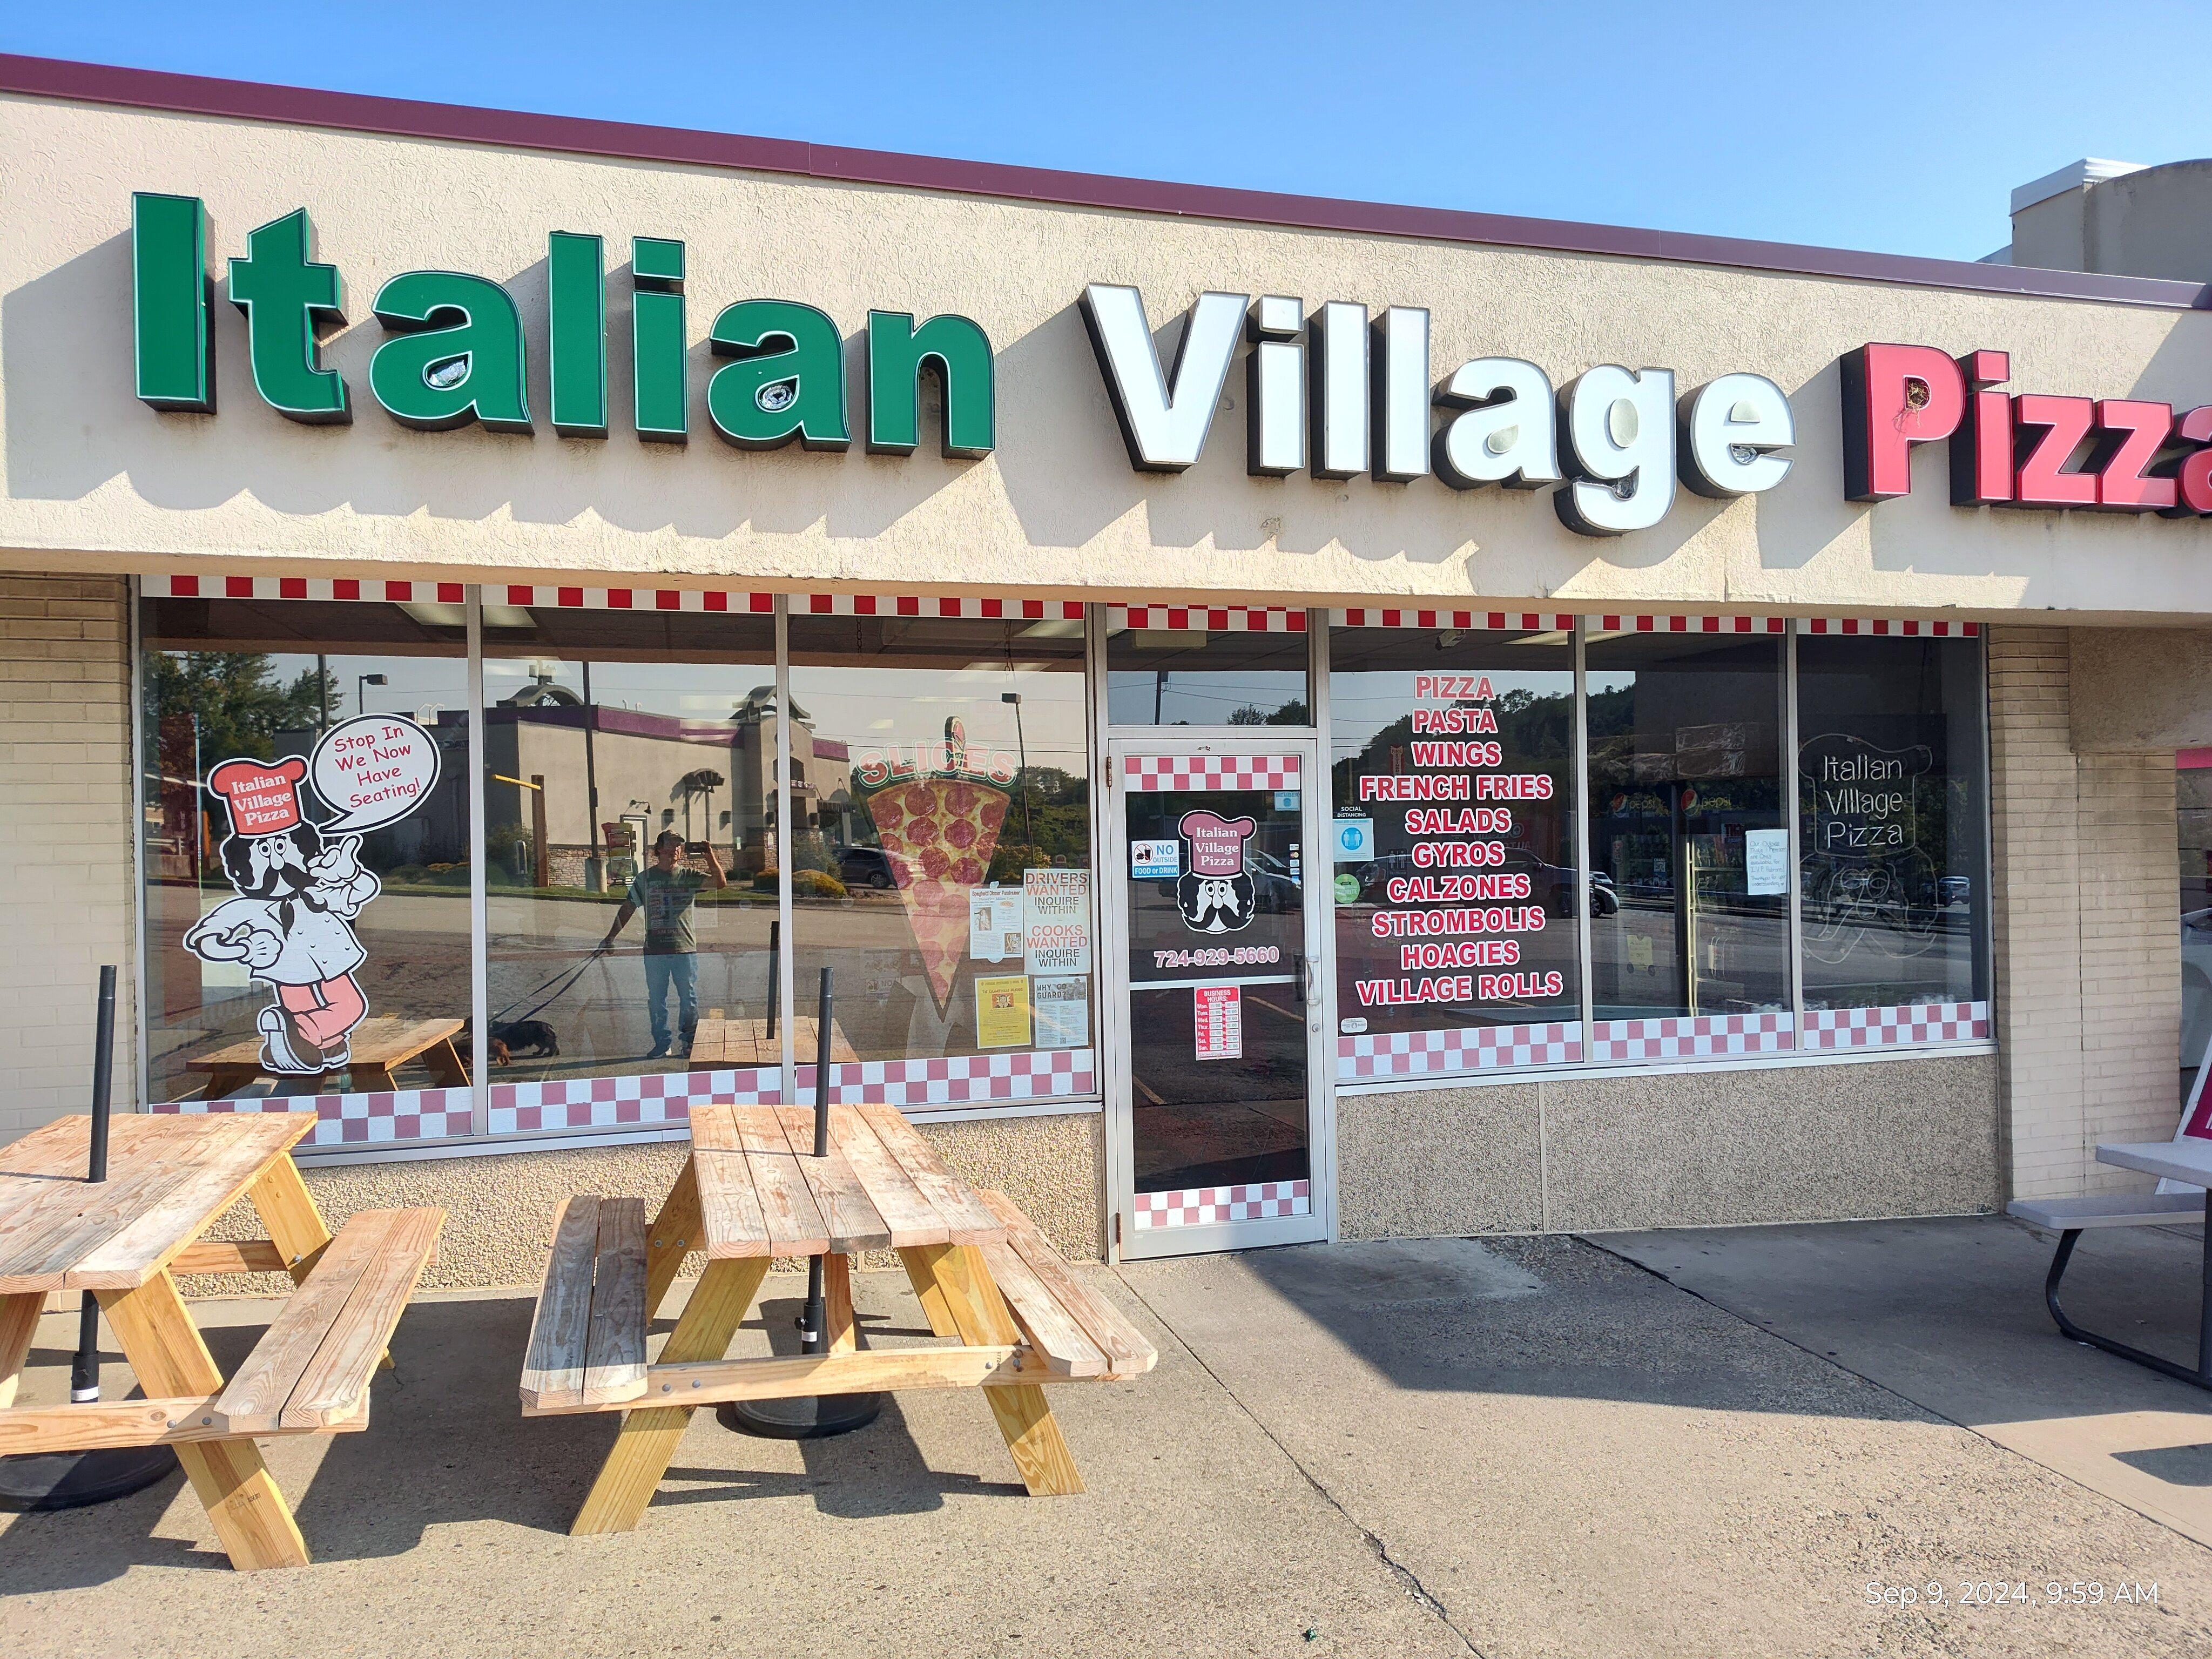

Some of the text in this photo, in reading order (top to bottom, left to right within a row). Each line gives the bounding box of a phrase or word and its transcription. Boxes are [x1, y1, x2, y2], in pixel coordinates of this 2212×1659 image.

[131, 191, 996, 460] Italian
[1082, 282, 1796, 539] Village
[1414, 675, 1496, 700] PIZZA
[1412, 709, 1498, 734] PASTA
[335, 725, 404, 753] Stop In
[335, 743, 411, 772] We Now
[856, 737, 1018, 788] SLICES
[1411, 741, 1502, 767] WINGS
[232, 774, 286, 794] Italian
[357, 766, 402, 786] Have
[350, 777, 422, 808] Seating!
[1360, 774, 1553, 801] FRENCH FRIES
[234, 791, 292, 812] Village
[245, 807, 290, 826] Pizza
[1405, 807, 1512, 835] SALADS
[1196, 827, 1237, 837] Italian
[1827, 822, 1903, 849] Pizza
[1157, 845, 1174, 855] NO
[1195, 842, 1239, 854] Village
[1412, 841, 1505, 868] GYROS
[1201, 856, 1234, 866] Pizza
[1026, 873, 1087, 884] DRIVERS
[1387, 873, 1531, 903] CALZONES
[1026, 885, 1087, 896] WANTED
[1035, 896, 1079, 906] INQUIRE
[1037, 906, 1076, 914] WITHIN
[1032, 925, 1083, 936] COOKS
[1372, 906, 1546, 938] STROMBOLIS
[1027, 936, 1088, 948] WANTED
[1035, 949, 1080, 958] INQUIRE
[1038, 958, 1077, 967] WITHIN
[1154, 946, 1279, 968] 724-929-5660
[1400, 940, 1520, 970] HOAGIES
[1355, 971, 1563, 1006] VILLAGE ROLLS
